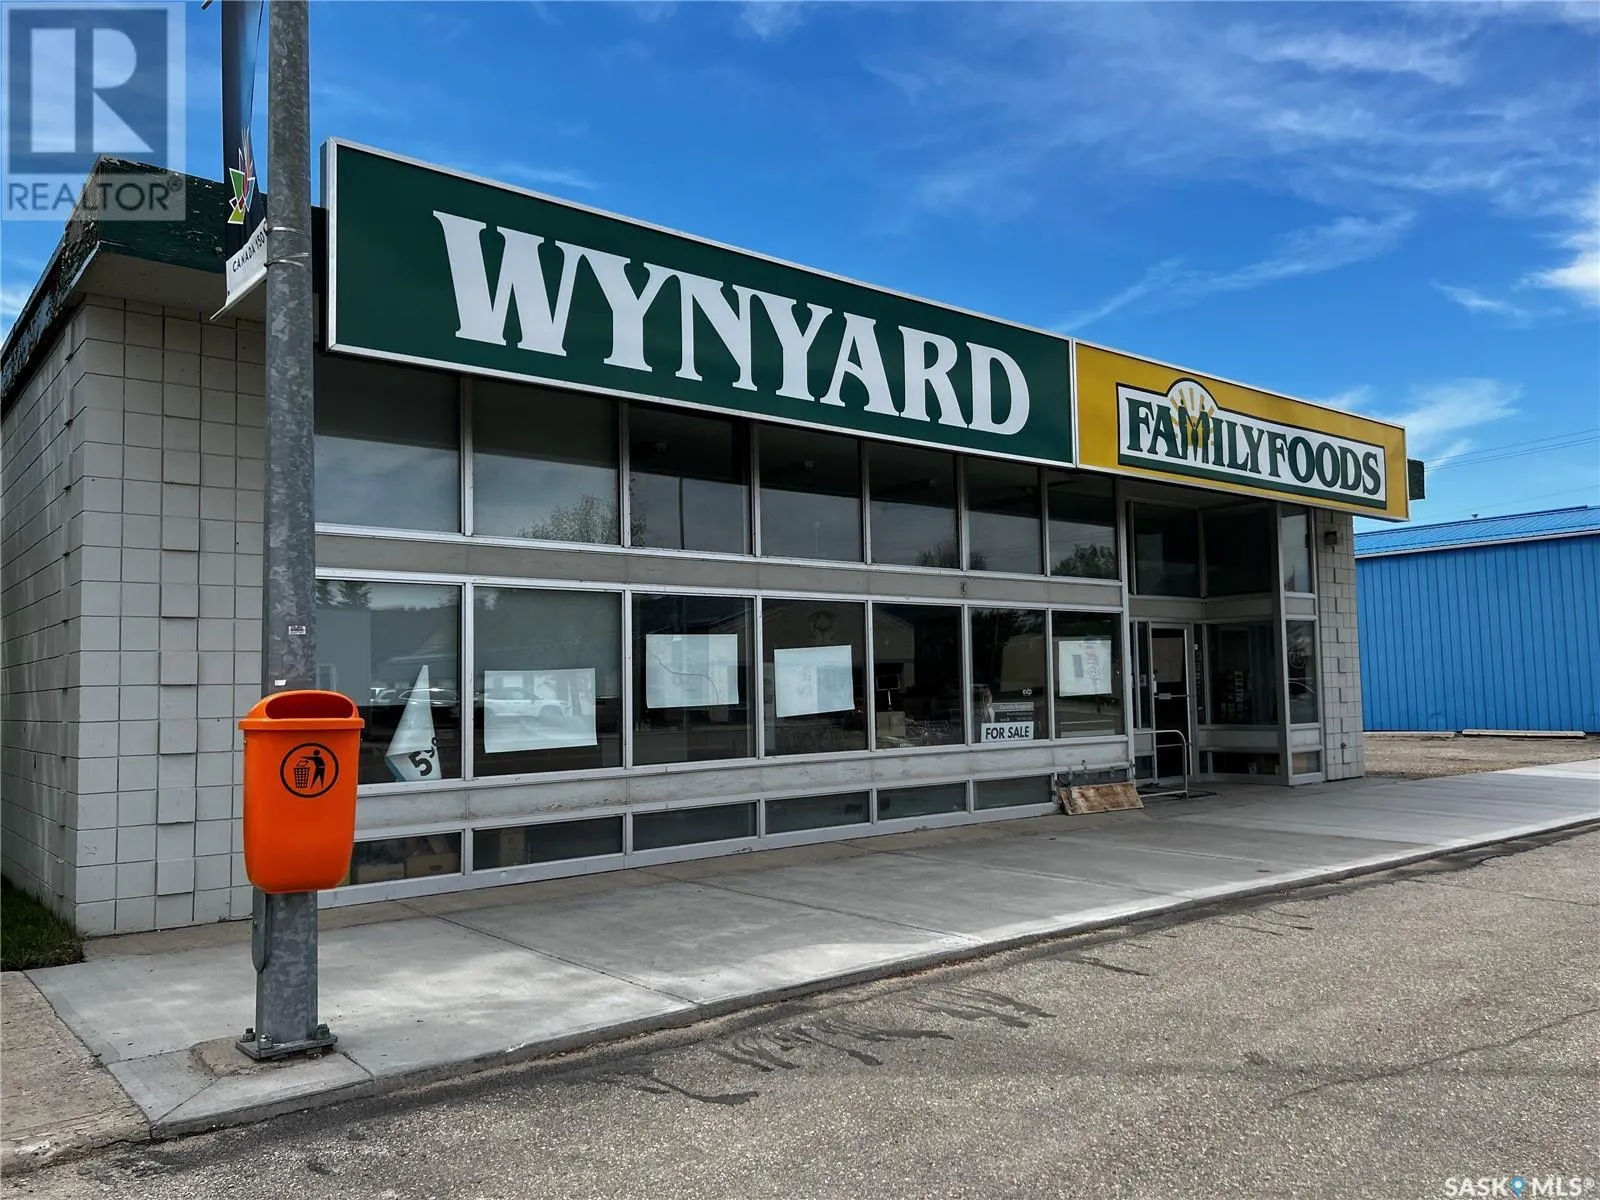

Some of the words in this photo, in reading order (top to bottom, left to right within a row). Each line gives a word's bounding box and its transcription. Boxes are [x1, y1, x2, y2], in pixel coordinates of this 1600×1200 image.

[233, 244, 256, 272] CANADA
[256, 231, 265, 250] 150
[433, 210, 1030, 436] WYNYARD
[985, 727, 1005, 739] FOR
[1007, 726, 1030, 738] SALE
